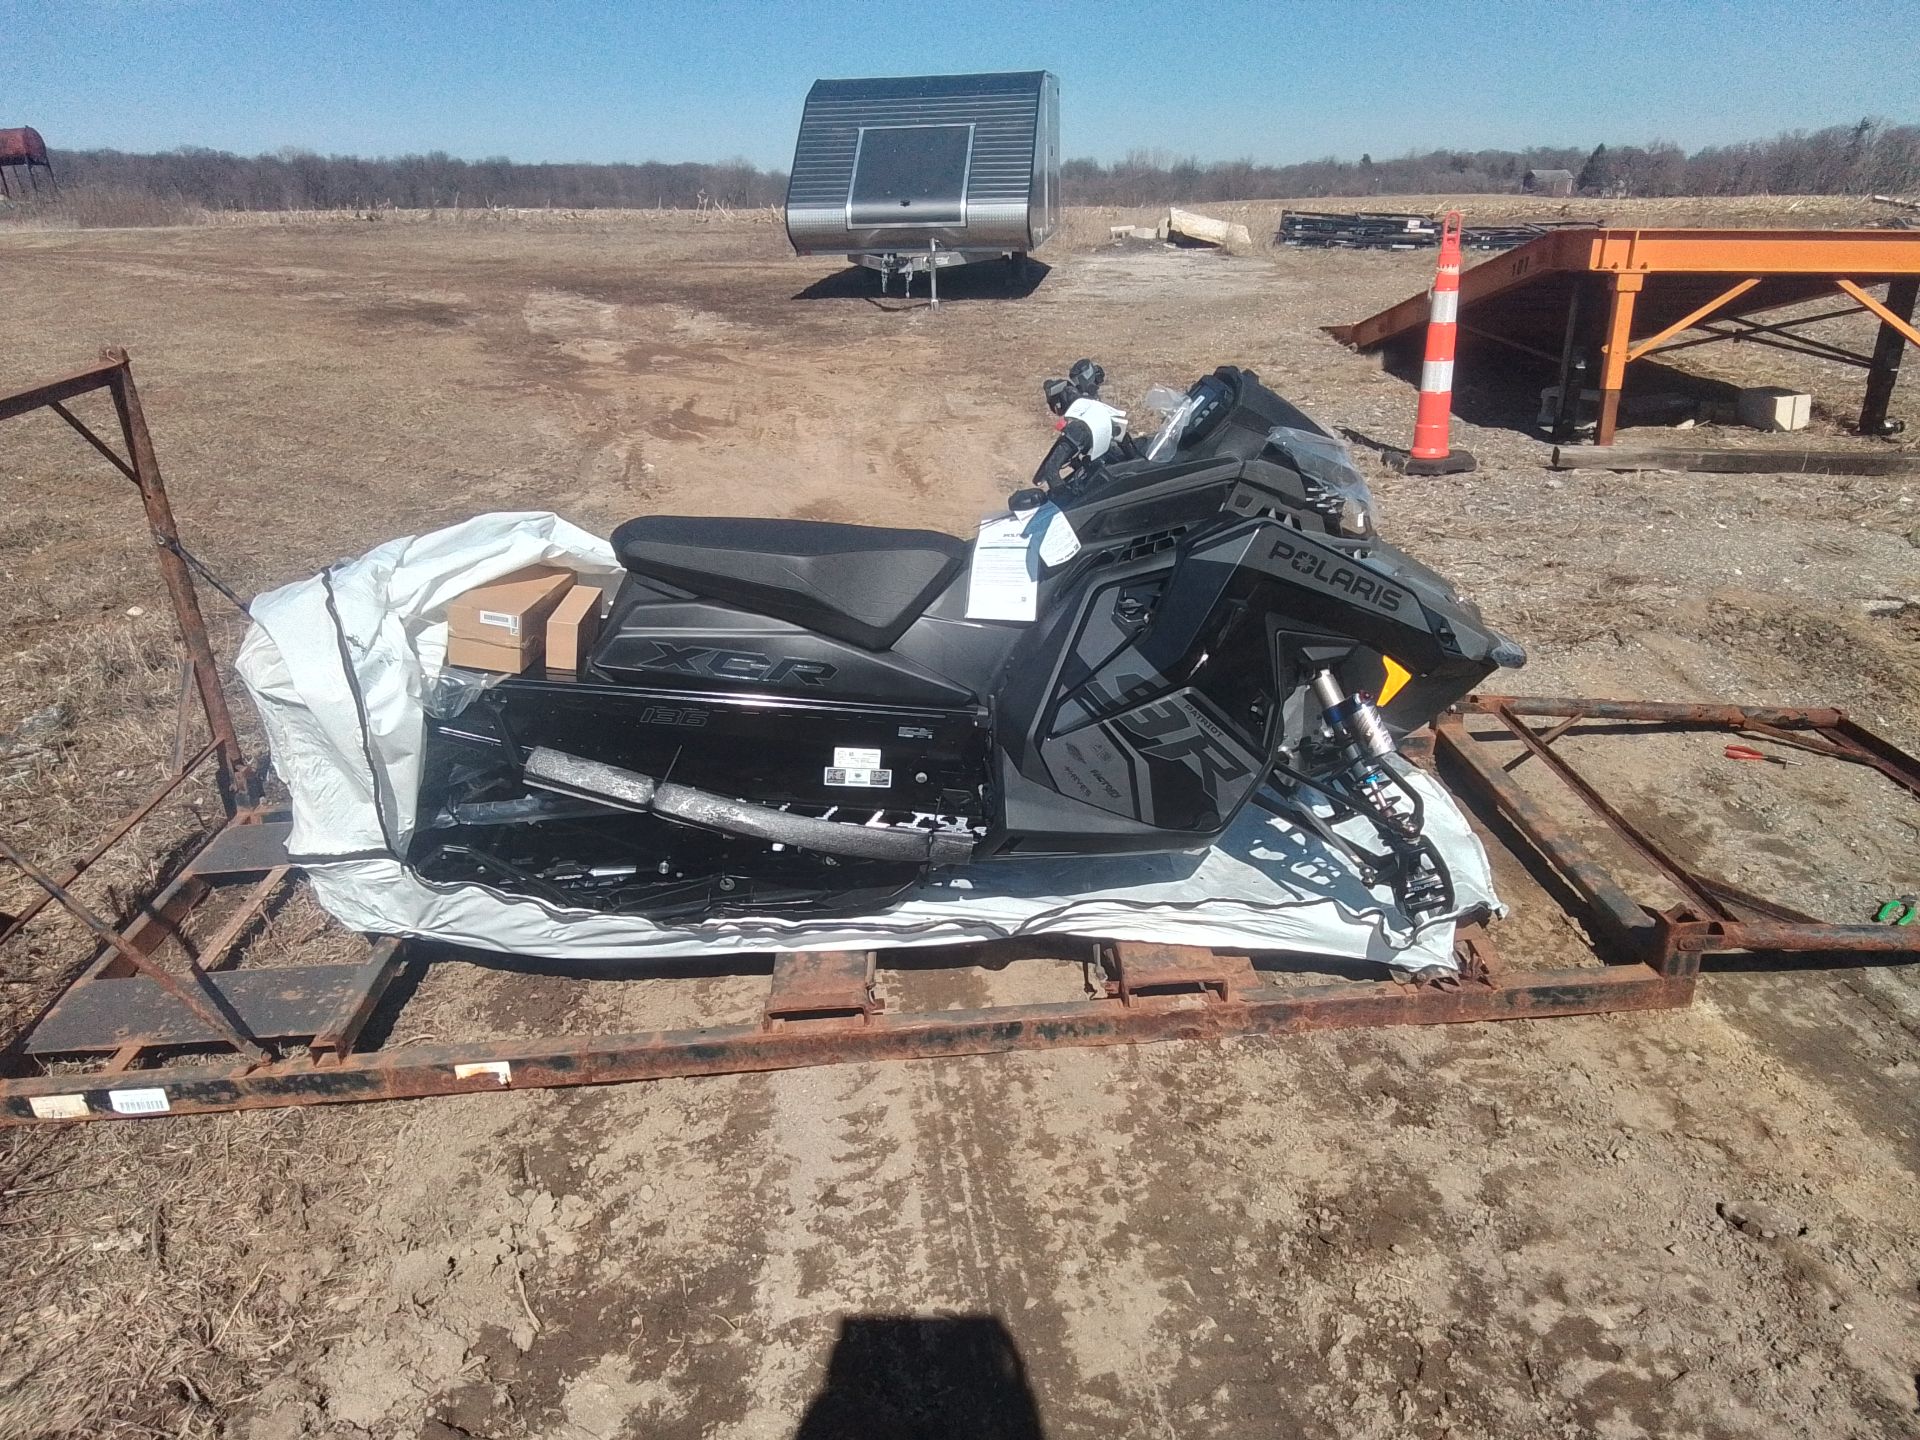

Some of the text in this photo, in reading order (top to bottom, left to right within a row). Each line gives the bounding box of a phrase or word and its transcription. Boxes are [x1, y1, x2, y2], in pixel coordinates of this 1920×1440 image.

[1268, 540, 1402, 612] POLARIS
[636, 641, 840, 686] XCR
[640, 706, 710, 727] 136
[1183, 704, 1225, 739] PATRIOT
